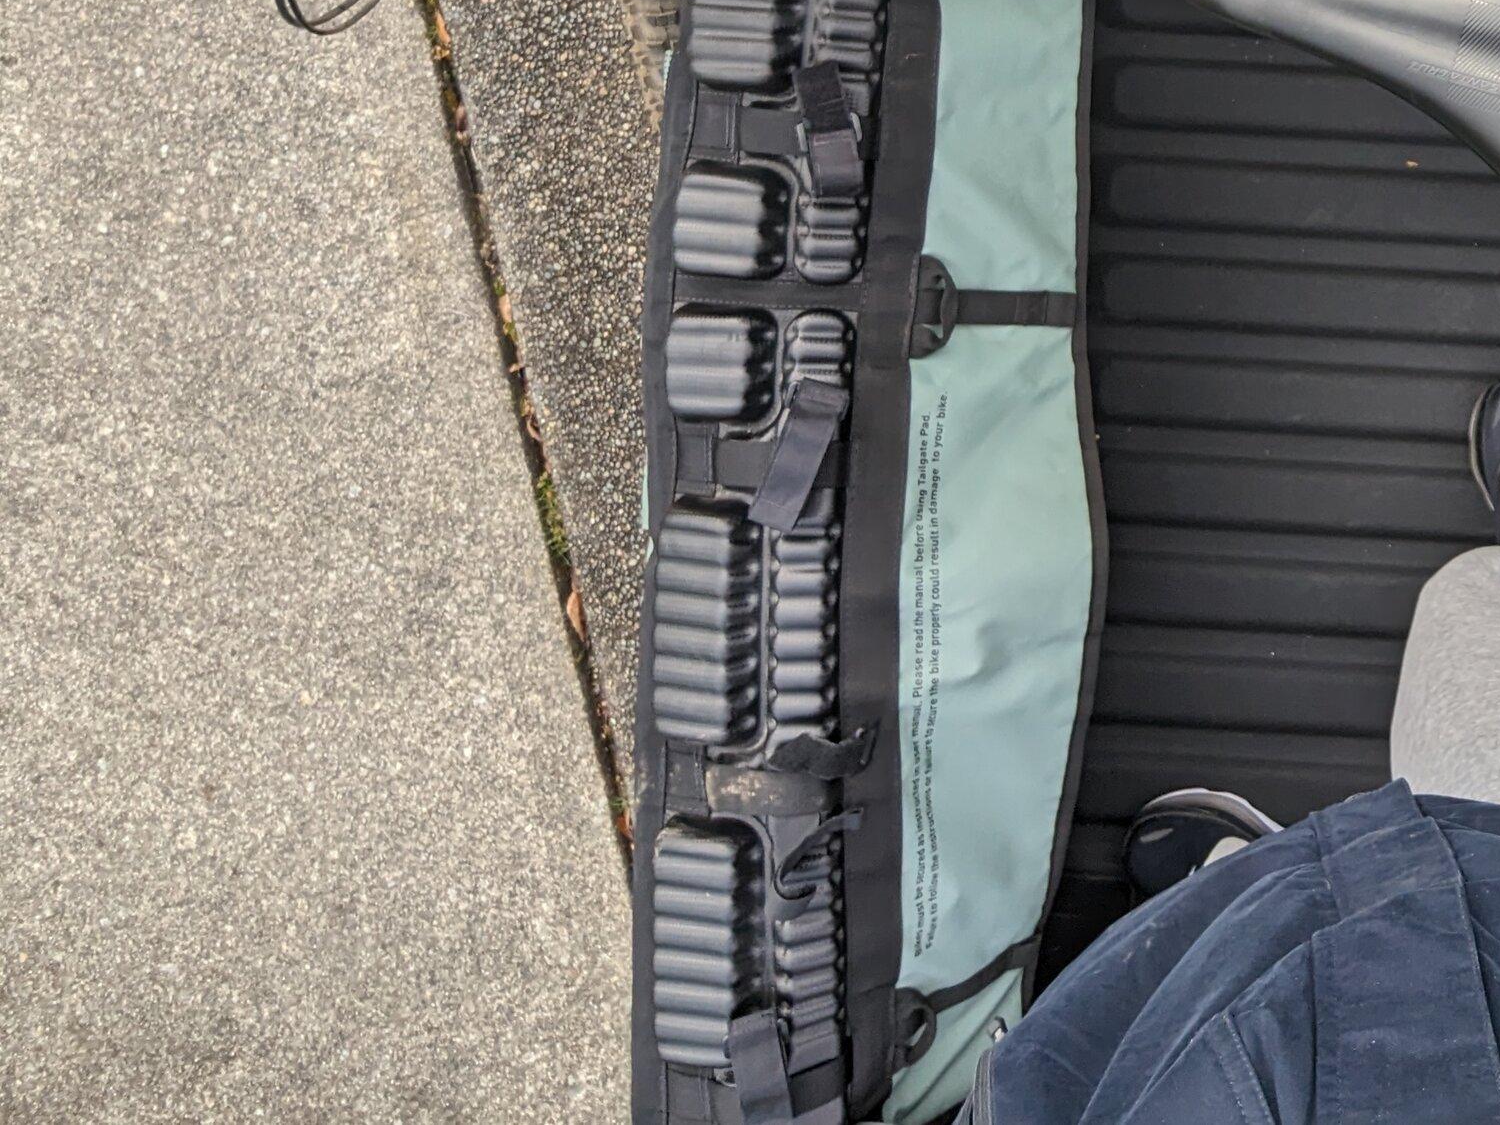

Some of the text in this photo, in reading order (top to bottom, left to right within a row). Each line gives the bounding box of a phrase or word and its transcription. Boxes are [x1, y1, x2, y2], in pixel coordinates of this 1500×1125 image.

[937, 391, 948, 419] bike.
[920, 412, 930, 436] Pad.
[933, 423, 943, 447] your
[918, 440, 928, 486] Tailgate
[932, 451, 940, 461] to
[929, 469, 941, 514] damage
[916, 489, 927, 521] using
[930, 518, 939, 527] in
[915, 525, 924, 562] before
[930, 531, 939, 565] result
[914, 566, 924, 608] manual
[930, 569, 940, 599] could
[913, 611, 924, 626] the
[930, 603, 942, 646] properly
[913, 629, 923, 654] read
[929, 650, 939, 674] bike
[913, 658, 923, 697] Please
[929, 678, 939, 695] the
[917, 834, 924, 846] as
[930, 855, 939, 871] the
[915, 886, 923, 900] be
[929, 873, 939, 901] follow
[915, 902, 924, 927] must
[929, 903, 938, 914] to
